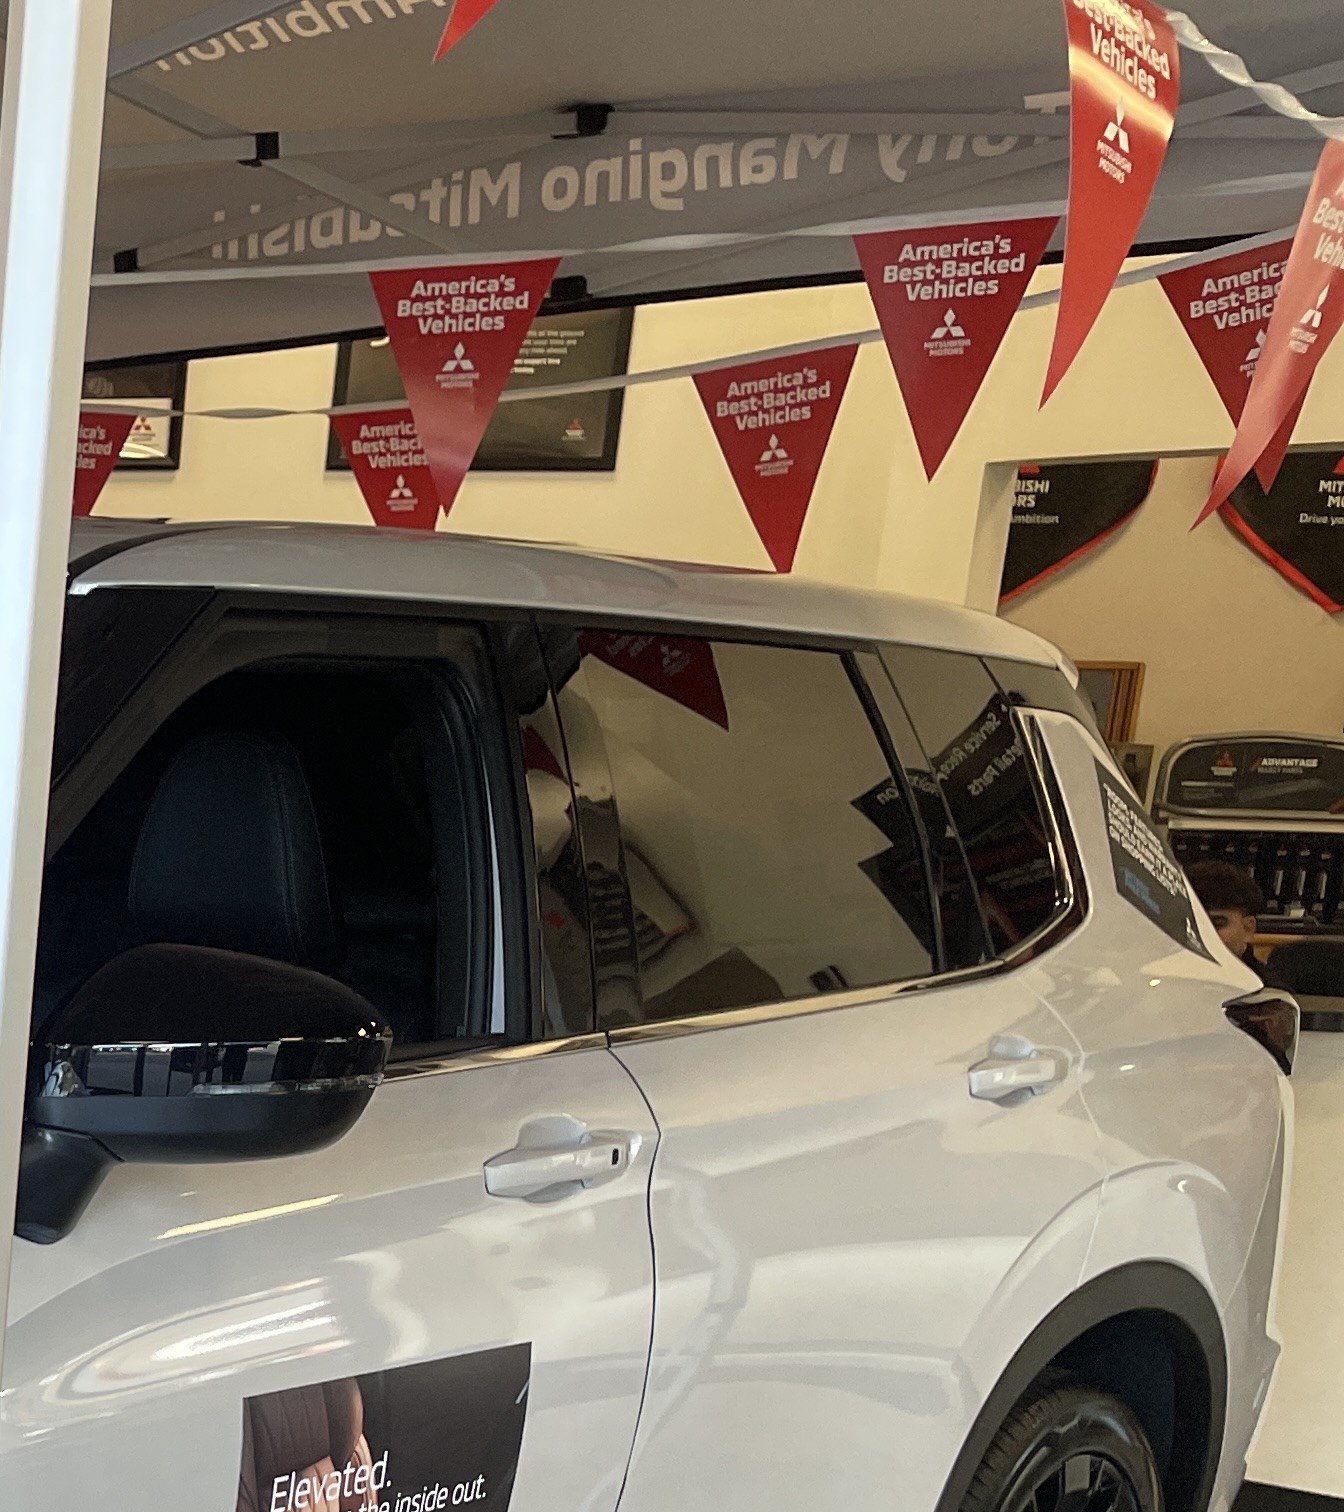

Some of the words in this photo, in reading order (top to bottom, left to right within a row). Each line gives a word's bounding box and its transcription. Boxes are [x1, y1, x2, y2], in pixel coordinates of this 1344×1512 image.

[1090, 23, 1156, 99] Vehicles
[898, 235, 1012, 262] America's
[411, 274, 516, 298] America's
[905, 277, 1000, 302] Vehicles
[417, 314, 506, 336] Vehicles
[1213, 302, 1274, 330] Vehic
[727, 367, 818, 398] America's
[735, 405, 812, 431] Vehicles
[1261, 757, 1319, 768] ADVANTAGE
[453, 1474, 487, 1505] out.
